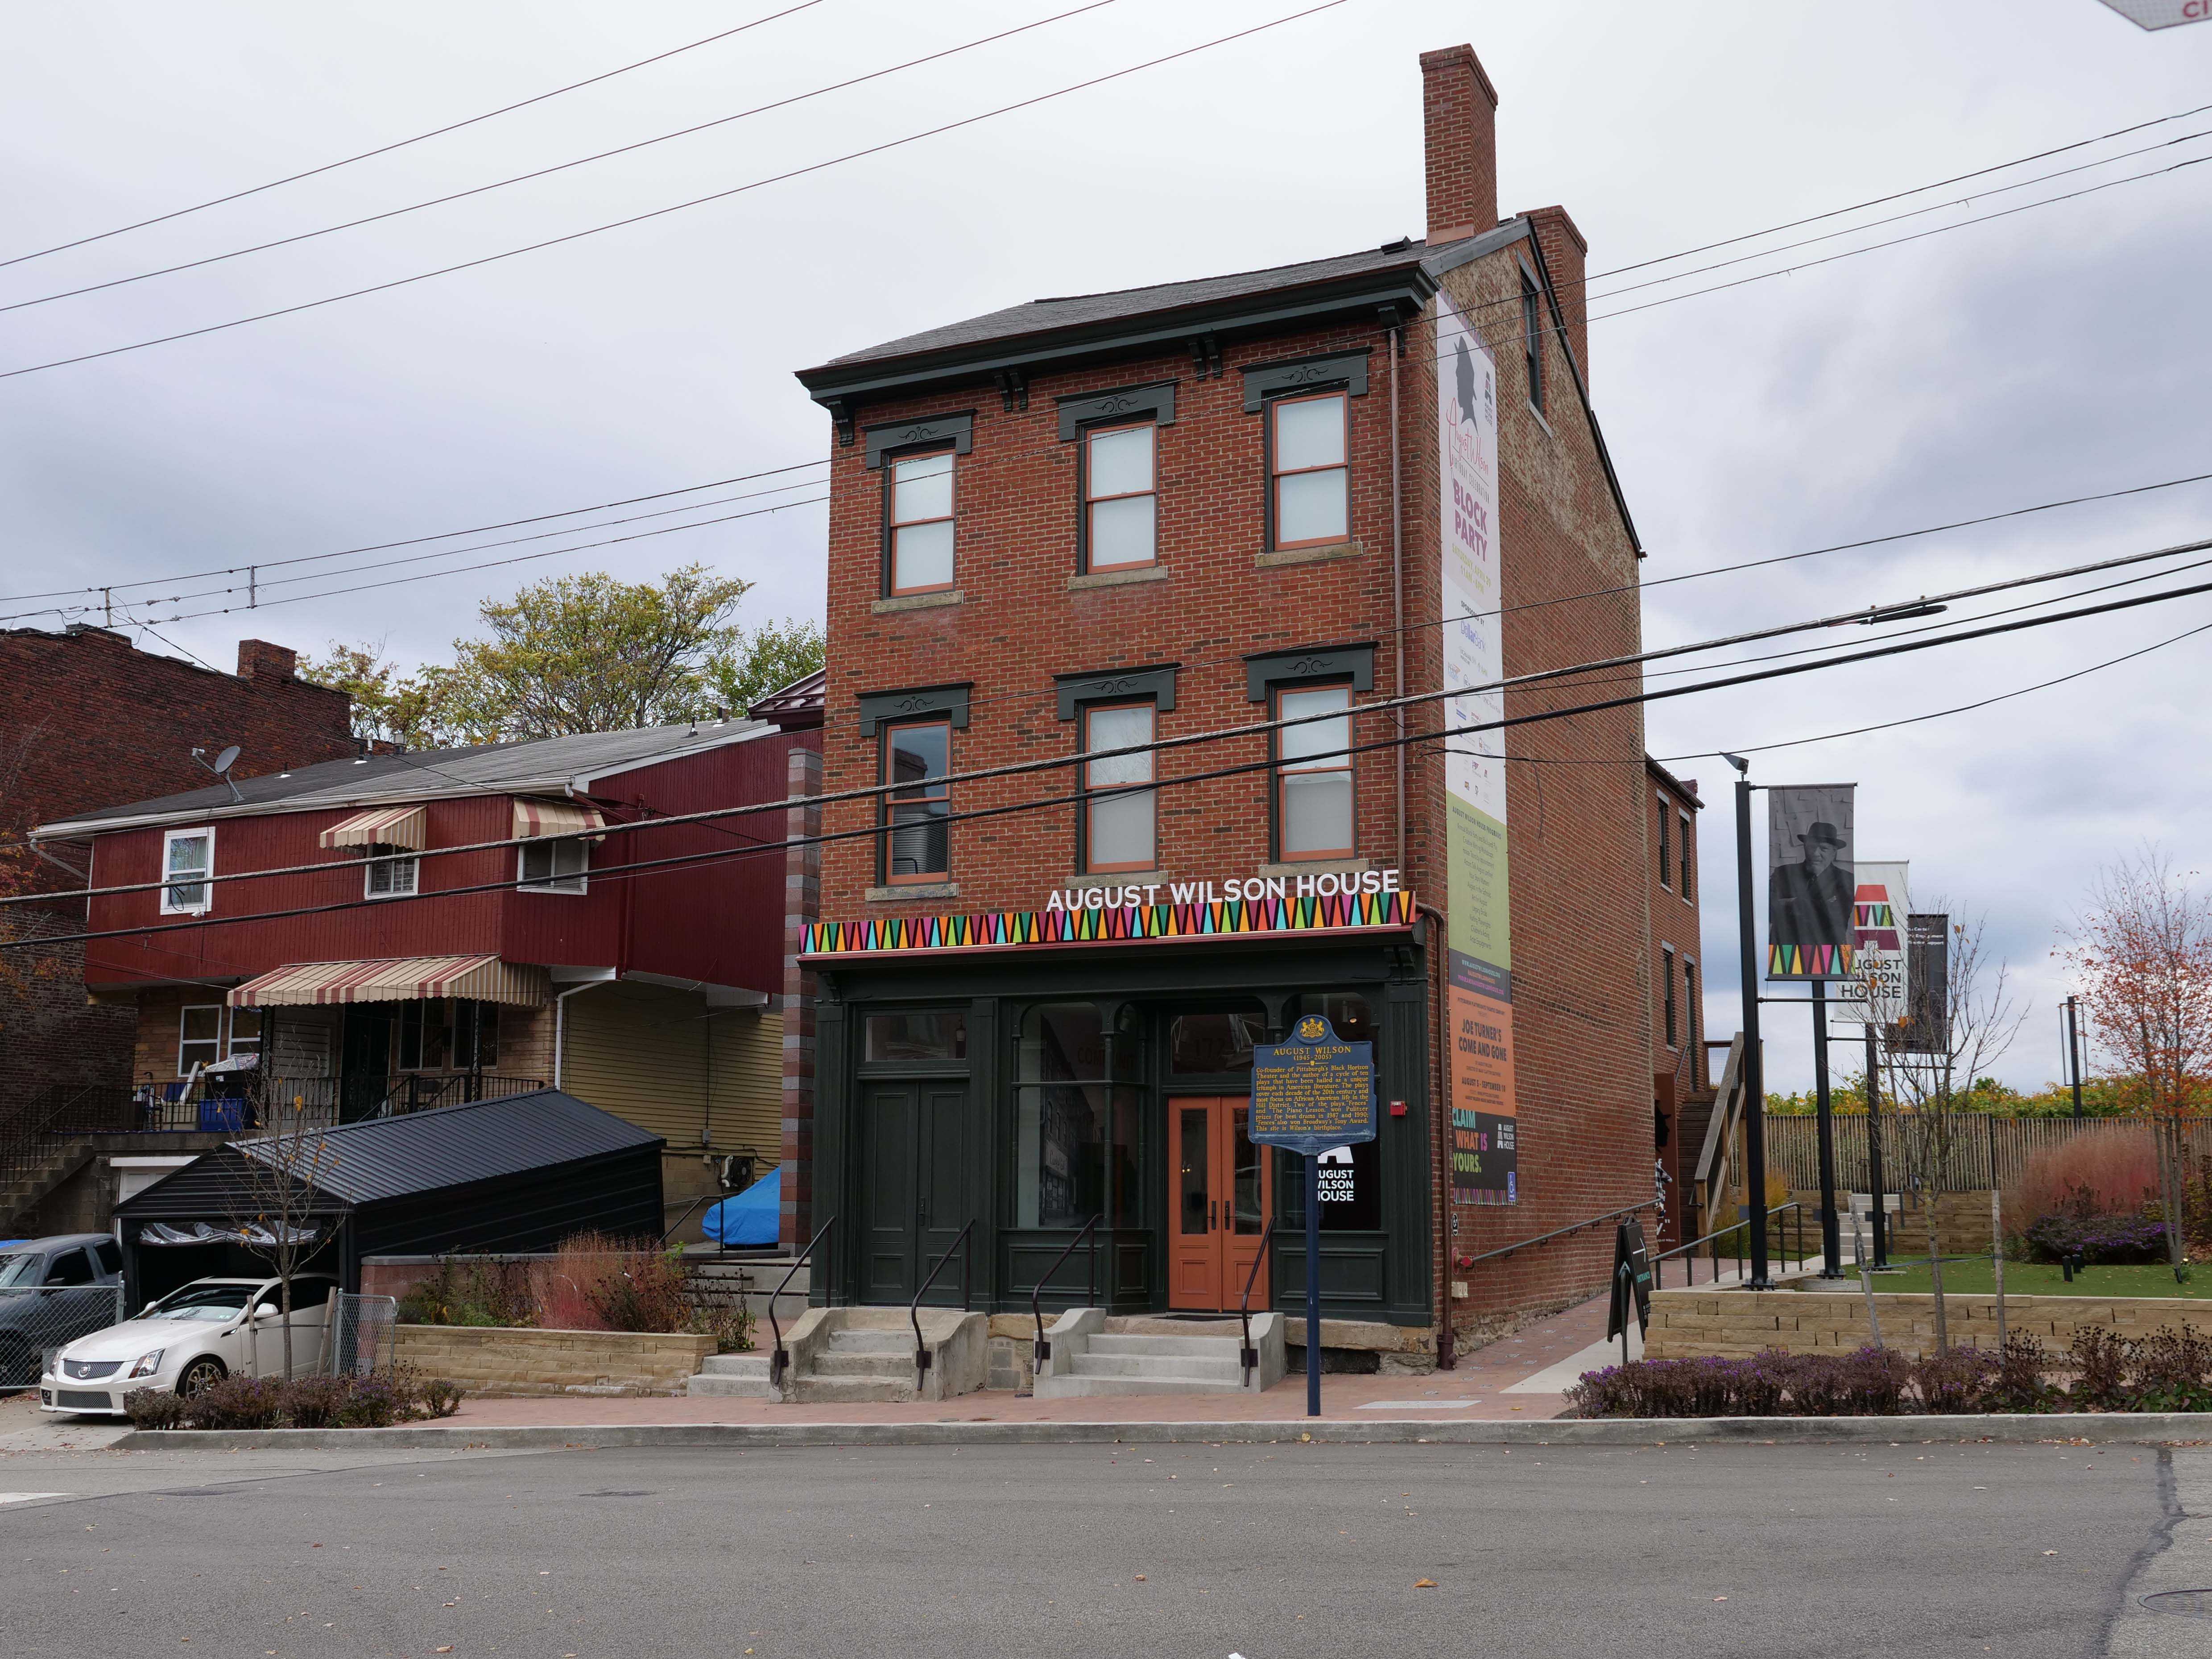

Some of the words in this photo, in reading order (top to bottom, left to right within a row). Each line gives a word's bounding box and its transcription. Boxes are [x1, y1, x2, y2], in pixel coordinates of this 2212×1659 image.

[1446, 397, 1471, 467] August
[1471, 437, 1488, 475] Wilson
[1453, 478, 1488, 535] BLOCK
[1454, 508, 1488, 562] PARTY
[1452, 544, 1474, 574] SATURDAY,
[1474, 565, 1485, 582] APRIL
[1461, 564, 1472, 583] 11AM
[1480, 618, 1484, 626] BY
[1452, 806, 1464, 818] AUGUST
[1464, 813, 1476, 825] WILSON
[1476, 820, 1486, 831] HOUSE
[1486, 825, 1501, 840] PROGRAMS
[1046, 884, 1161, 912] AUGUST
[1170, 877, 1285, 904] WILSON
[1297, 869, 1400, 897] HOUSE
[1855, 959, 1902, 970] UGUST
[1870, 972, 1902, 983] SON
[1842, 985, 1902, 999] HOUSE
[1462, 1018, 1474, 1036] JOE
[1474, 1021, 1502, 1043] TURNER'S
[1274, 1048, 1311, 1056] AUGUST
[1315, 1046, 1351, 1054] WILSON
[1458, 1036, 1477, 1056] COME
[1478, 1040, 1491, 1058] AND
[1491, 1042, 1507, 1061] GONE
[1462, 1077, 1476, 1086] AUGUST
[1482, 1081, 1501, 1091] SEPTEMBER
[1452, 1108, 1476, 1129] CLAIM
[1455, 1130, 1479, 1150] WHAT
[1480, 1133, 1488, 1151] IS
[1504, 1141, 1514, 1150] HOUSE
[1453, 1152, 1481, 1173] YOURS.
[1318, 1170, 1354, 1179] UGUST
[1637, 1271, 1650, 1283] ENTRANCE
